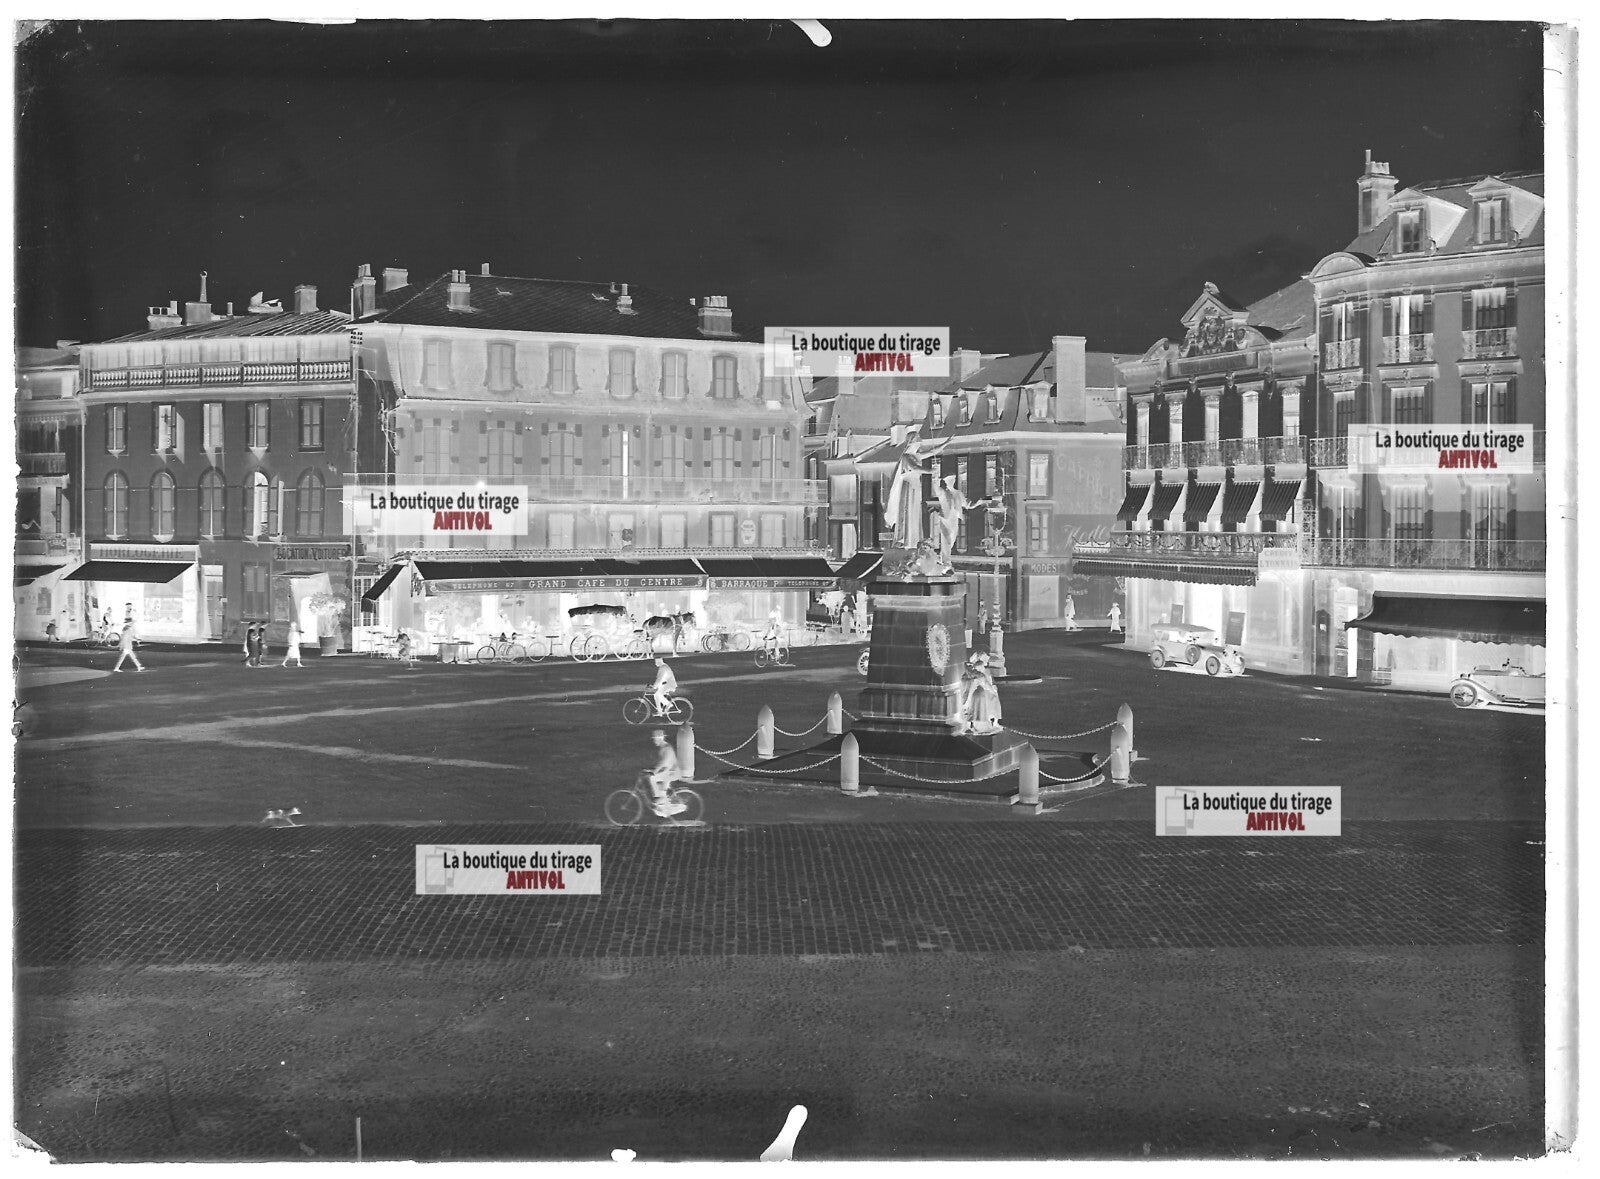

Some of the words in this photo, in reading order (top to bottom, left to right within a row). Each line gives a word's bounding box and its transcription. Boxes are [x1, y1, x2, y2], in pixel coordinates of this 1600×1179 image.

[98, 546, 185, 559] HORLOGERIE
[1031, 563, 1057, 573] MODES
[529, 580, 567, 588] GRAND
[577, 579, 606, 587] CAFE
[640, 578, 683, 586] CENTRE
[722, 580, 768, 588] BARRAQUE
